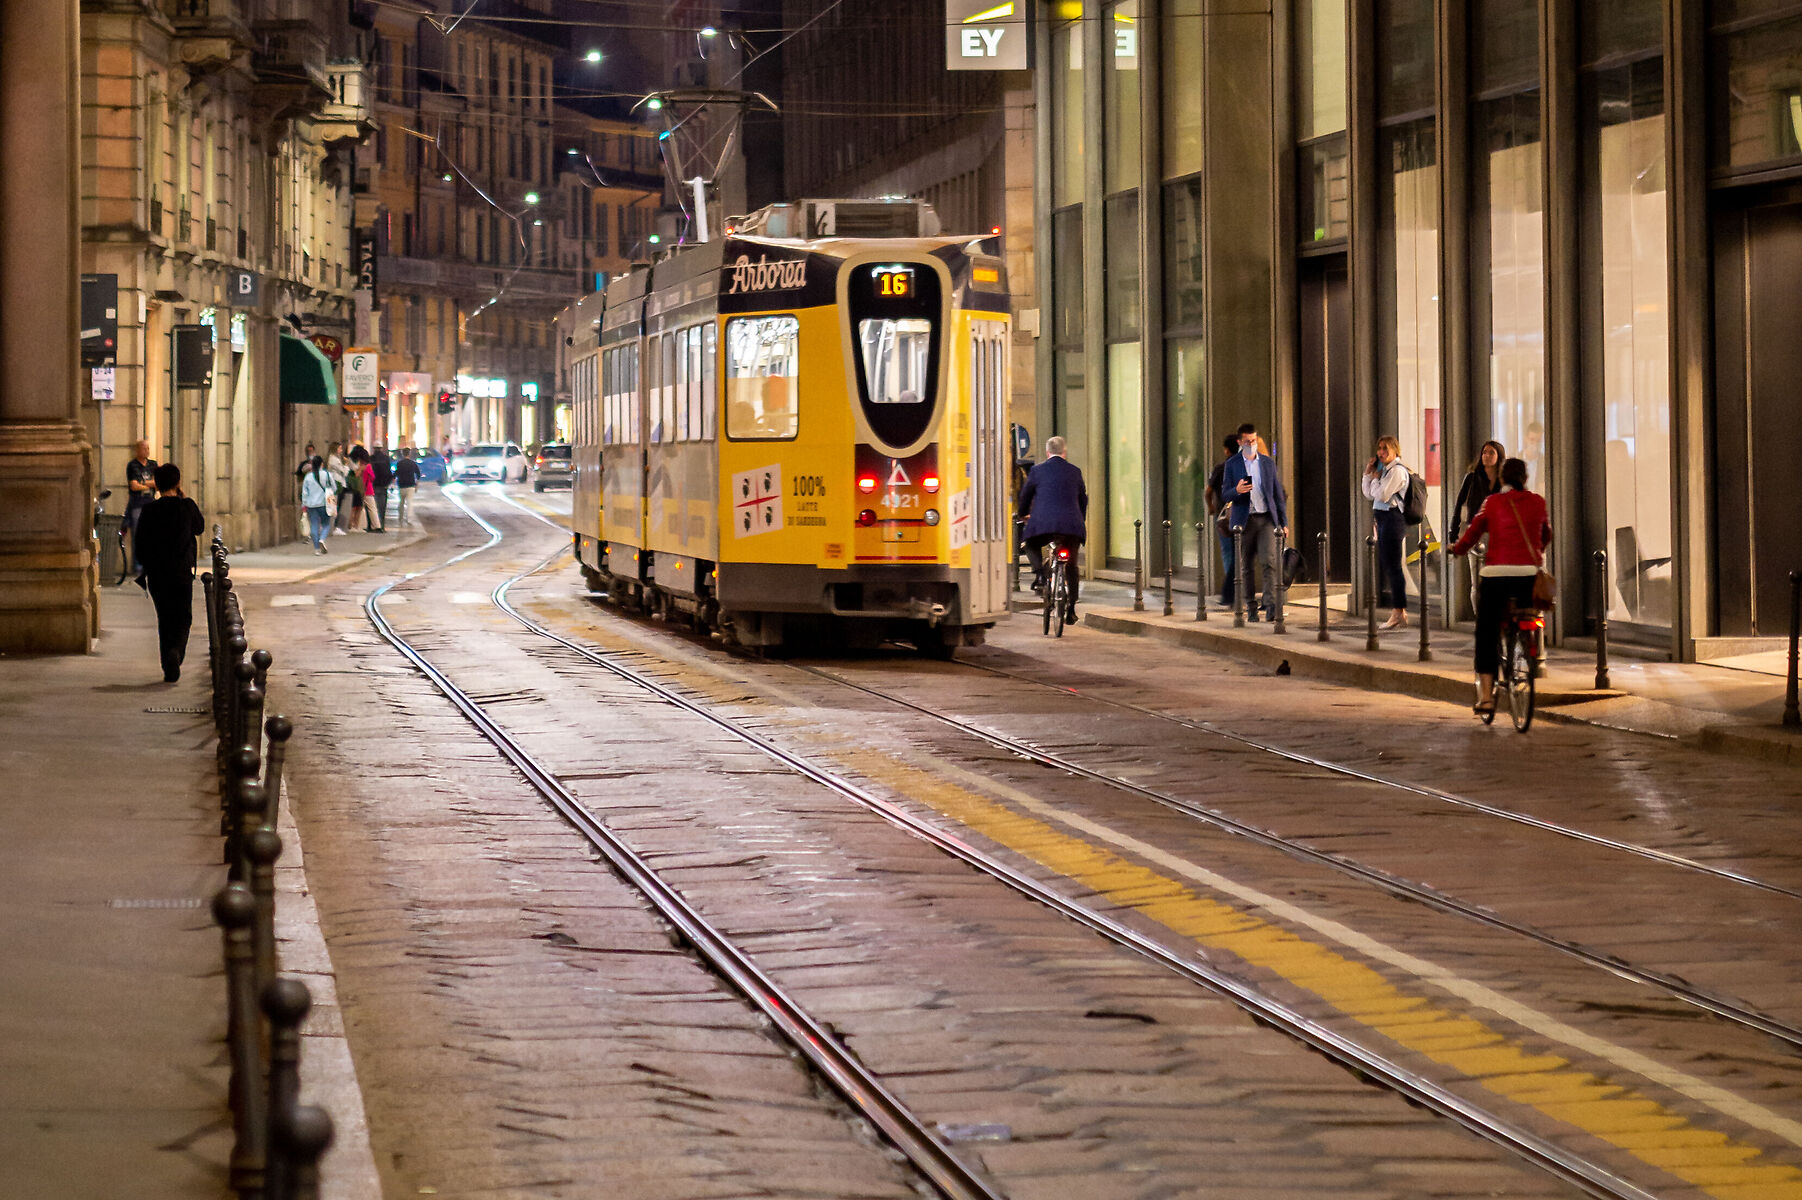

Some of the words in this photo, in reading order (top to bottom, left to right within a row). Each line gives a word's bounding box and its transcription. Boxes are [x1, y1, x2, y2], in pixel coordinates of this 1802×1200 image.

[961, 29, 1005, 57] EY
[360, 241, 374, 300] TASCH
[729, 253, 808, 295] Arborea
[239, 273, 252, 294] B
[880, 272, 908, 296] 16
[314, 337, 336, 352] AR
[793, 475, 826, 497] 100%
